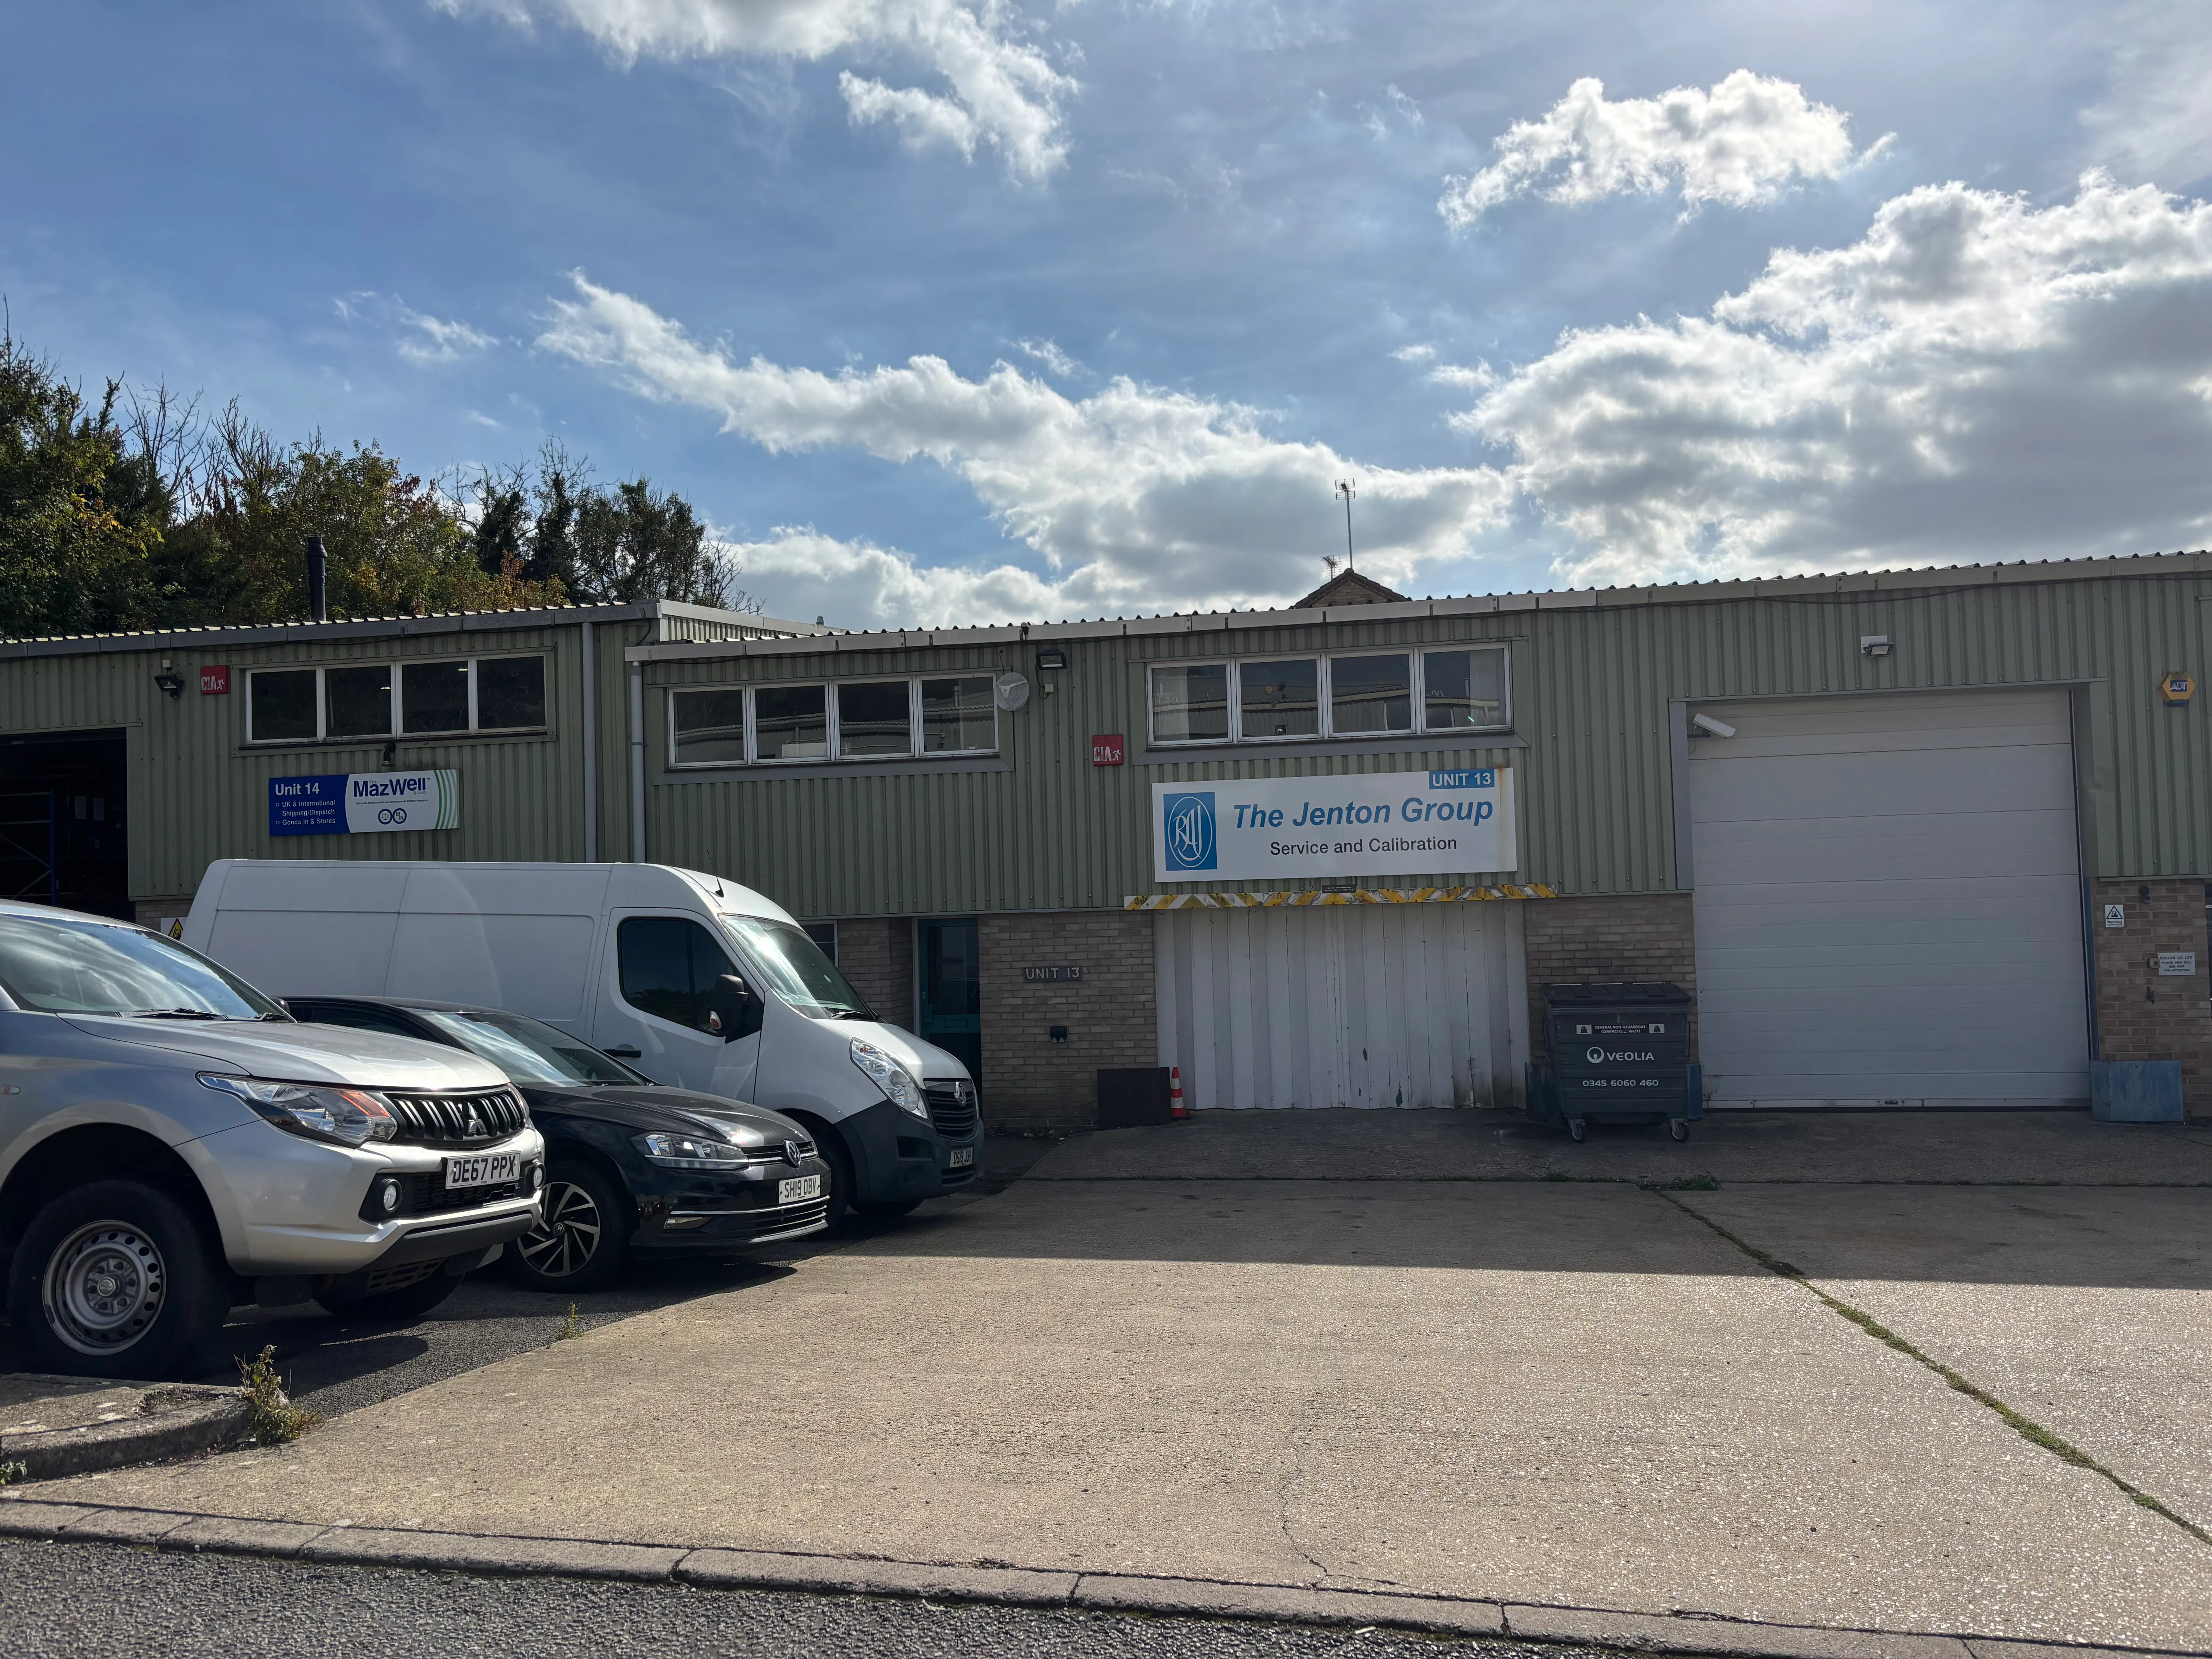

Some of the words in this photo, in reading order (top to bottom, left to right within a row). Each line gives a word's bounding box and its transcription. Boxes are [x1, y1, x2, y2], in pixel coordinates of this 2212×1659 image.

[201, 676, 216, 690] CIA
[2170, 682, 2187, 690] ADT
[1094, 747, 1112, 762] CIA
[1432, 773, 1469, 787] UNIT
[1474, 772, 1491, 785] 13
[275, 783, 301, 796] Unit
[305, 783, 319, 794] 14
[354, 778, 426, 797] MazWell
[282, 809, 335, 817] Shipping/Dispatch
[1234, 804, 1283, 828] The
[1292, 801, 1391, 827] Jenton
[1401, 797, 1493, 826] Group
[1270, 841, 1328, 855] Service
[1334, 839, 1363, 853] and
[1369, 836, 1457, 852] Calibration
[1026, 968, 1059, 979] UNIT
[1067, 967, 1080, 978] 13
[1606, 1052, 1654, 1061] VEOLIA
[452, 1158, 489, 1183] DE67
[490, 1155, 516, 1179] PPX
[785, 1180, 802, 1199] SH19
